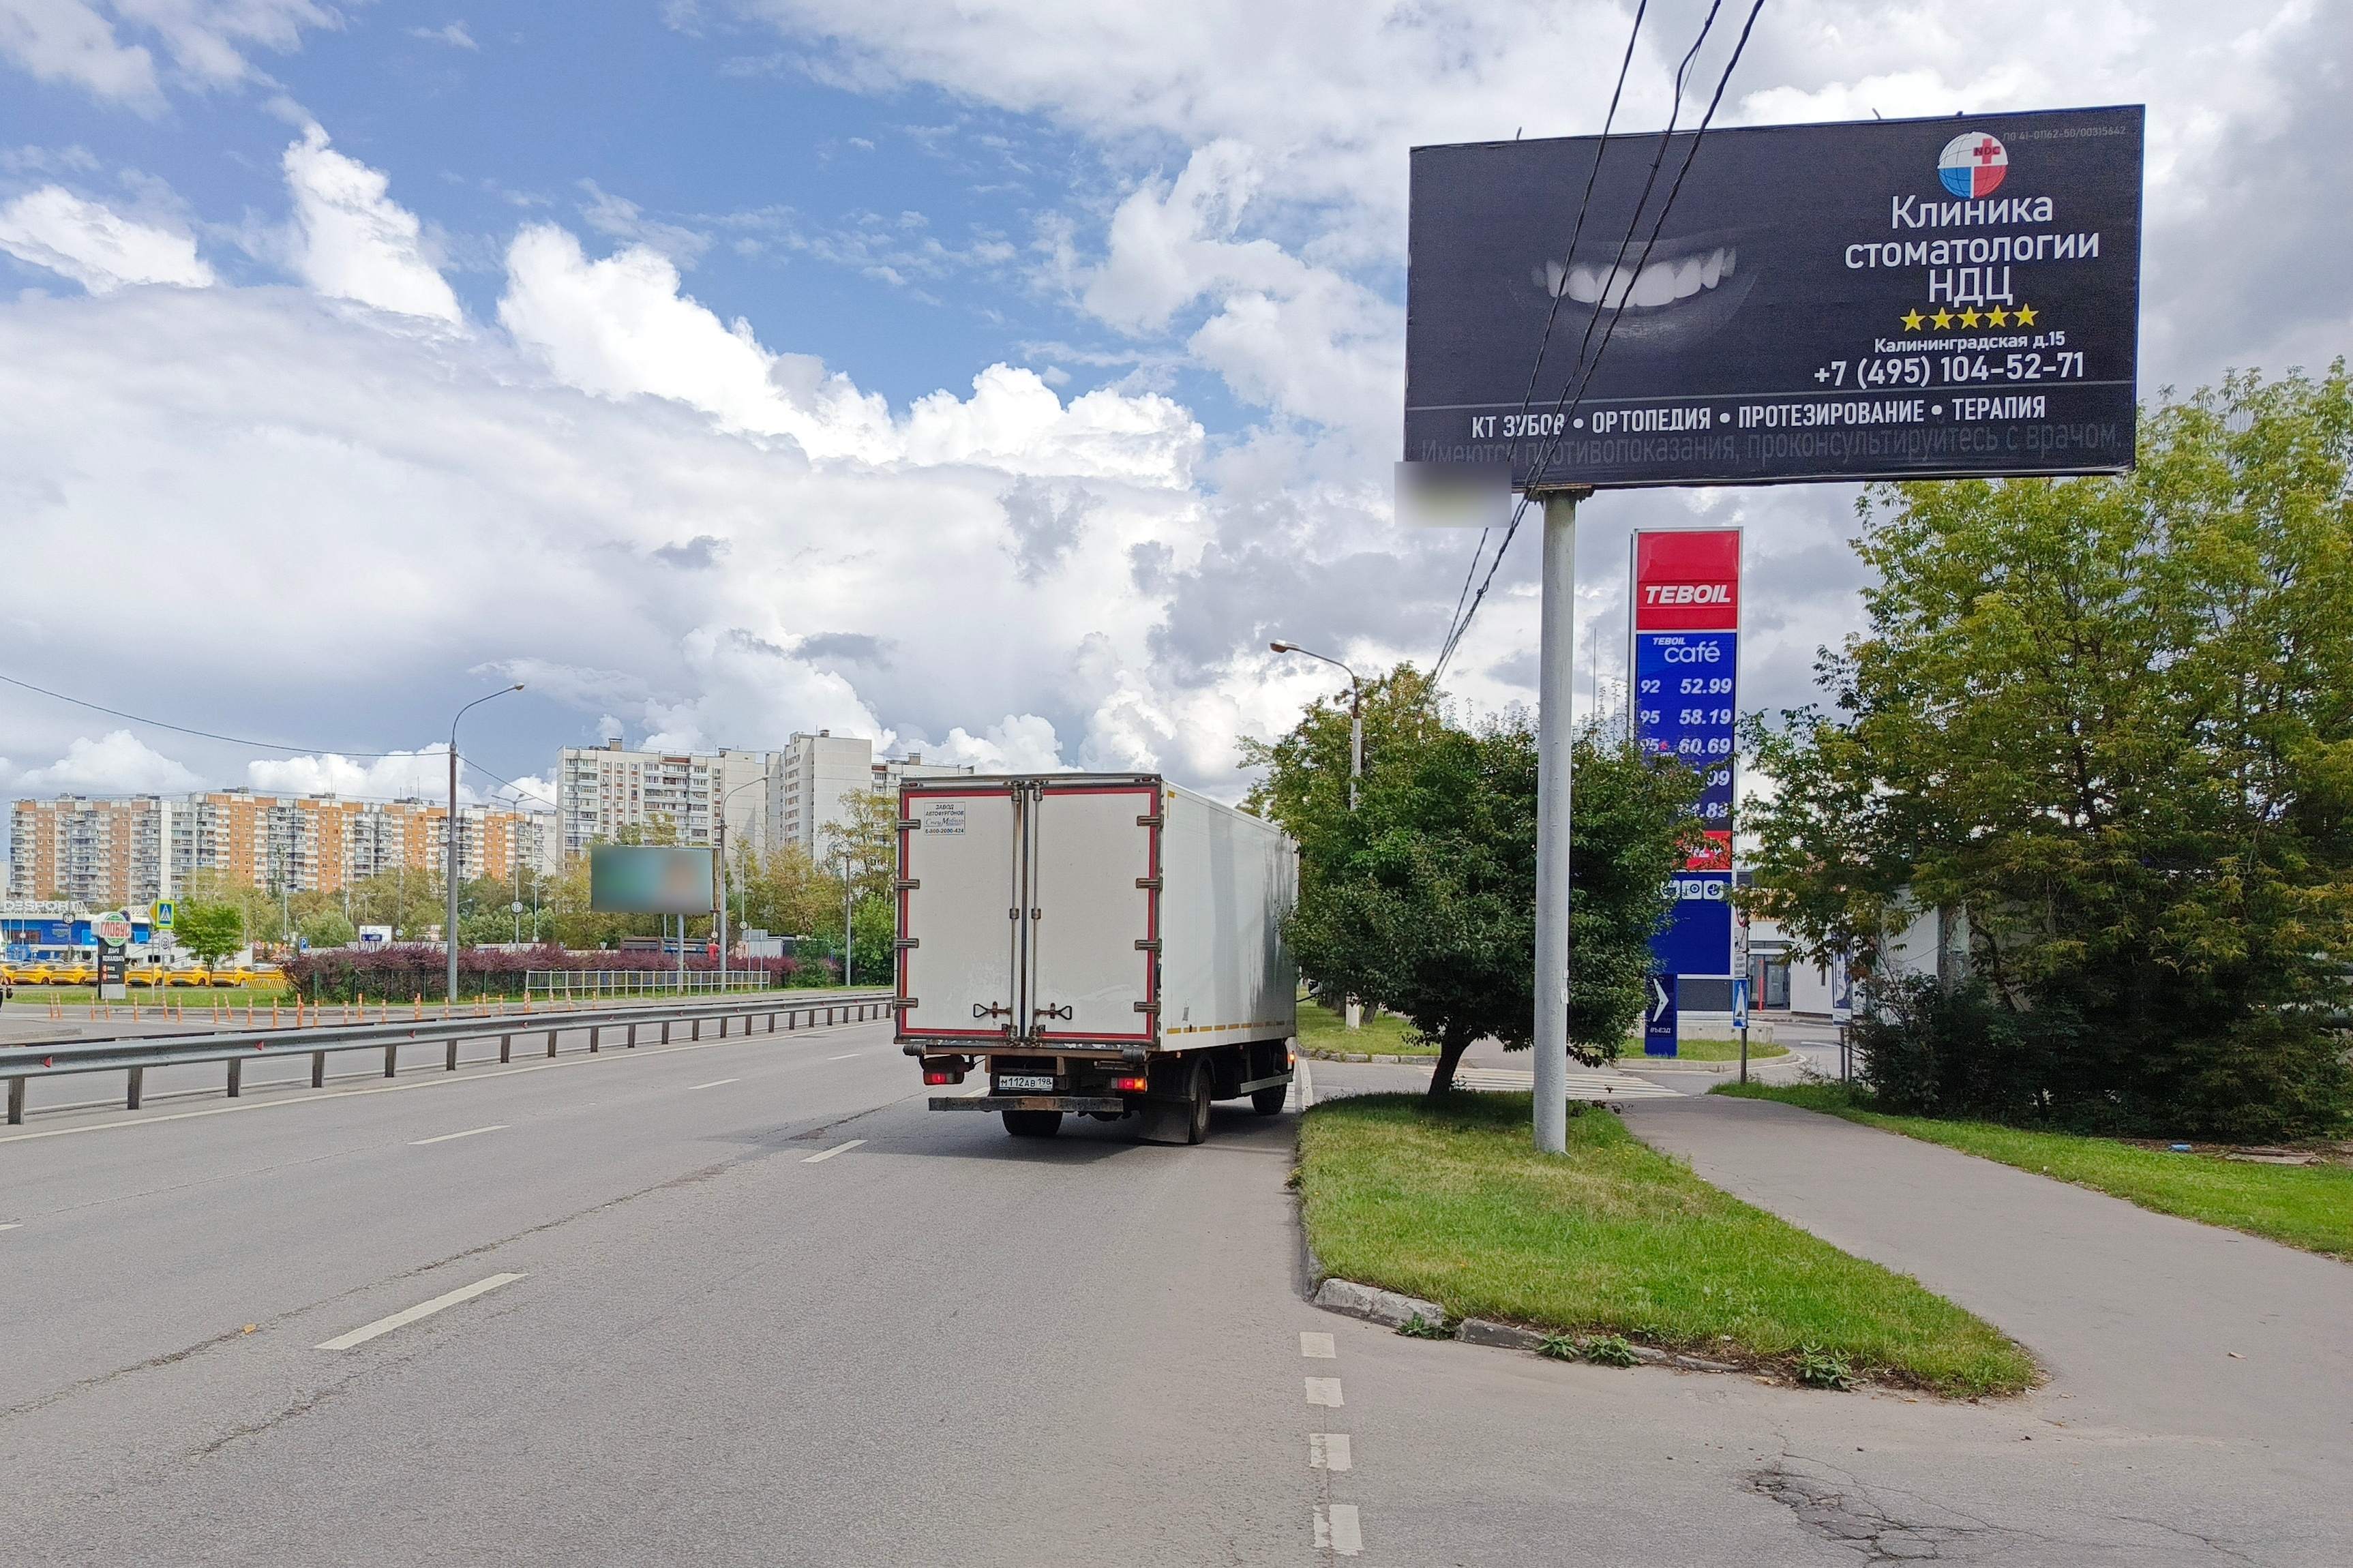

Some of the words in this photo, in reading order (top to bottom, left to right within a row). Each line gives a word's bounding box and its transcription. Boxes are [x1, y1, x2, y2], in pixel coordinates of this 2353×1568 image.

[1973, 145, 2001, 157] NDC
[1891, 195, 2053, 229] Клиника
[1845, 232, 2099, 269] стоматологии
[1929, 266, 2013, 307] НДЦ
[1874, 333, 2028, 354] Калининградская
[2033, 331, 2066, 350] д.15
[1814, 361, 1846, 387] +7
[1857, 355, 1931, 390] (495)
[1940, 351, 2084, 382] 104-52-71
[1471, 415, 1497, 439] КТ
[1503, 413, 1566, 438] ЗУБОВ
[1591, 408, 1711, 434] ОРТОПЕДИЯ
[1737, 399, 1925, 429] ПРОТЕЗИРОВАНИЕ
[1951, 395, 2046, 421] ТЕРАПИЯ
[2006, 425, 2019, 451] с
[1645, 584, 1731, 604] TEBOIL
[1653, 637, 1686, 646] TEBOIL
[1664, 640, 1721, 663] café
[1640, 679, 1661, 694] 92
[1679, 678, 1732, 695] 52.99
[1640, 710, 1660, 724] 95
[1679, 708, 1731, 725] 58.19
[1679, 737, 1731, 755] 60.69
[100, 921, 130, 937] ГЛОБУС
